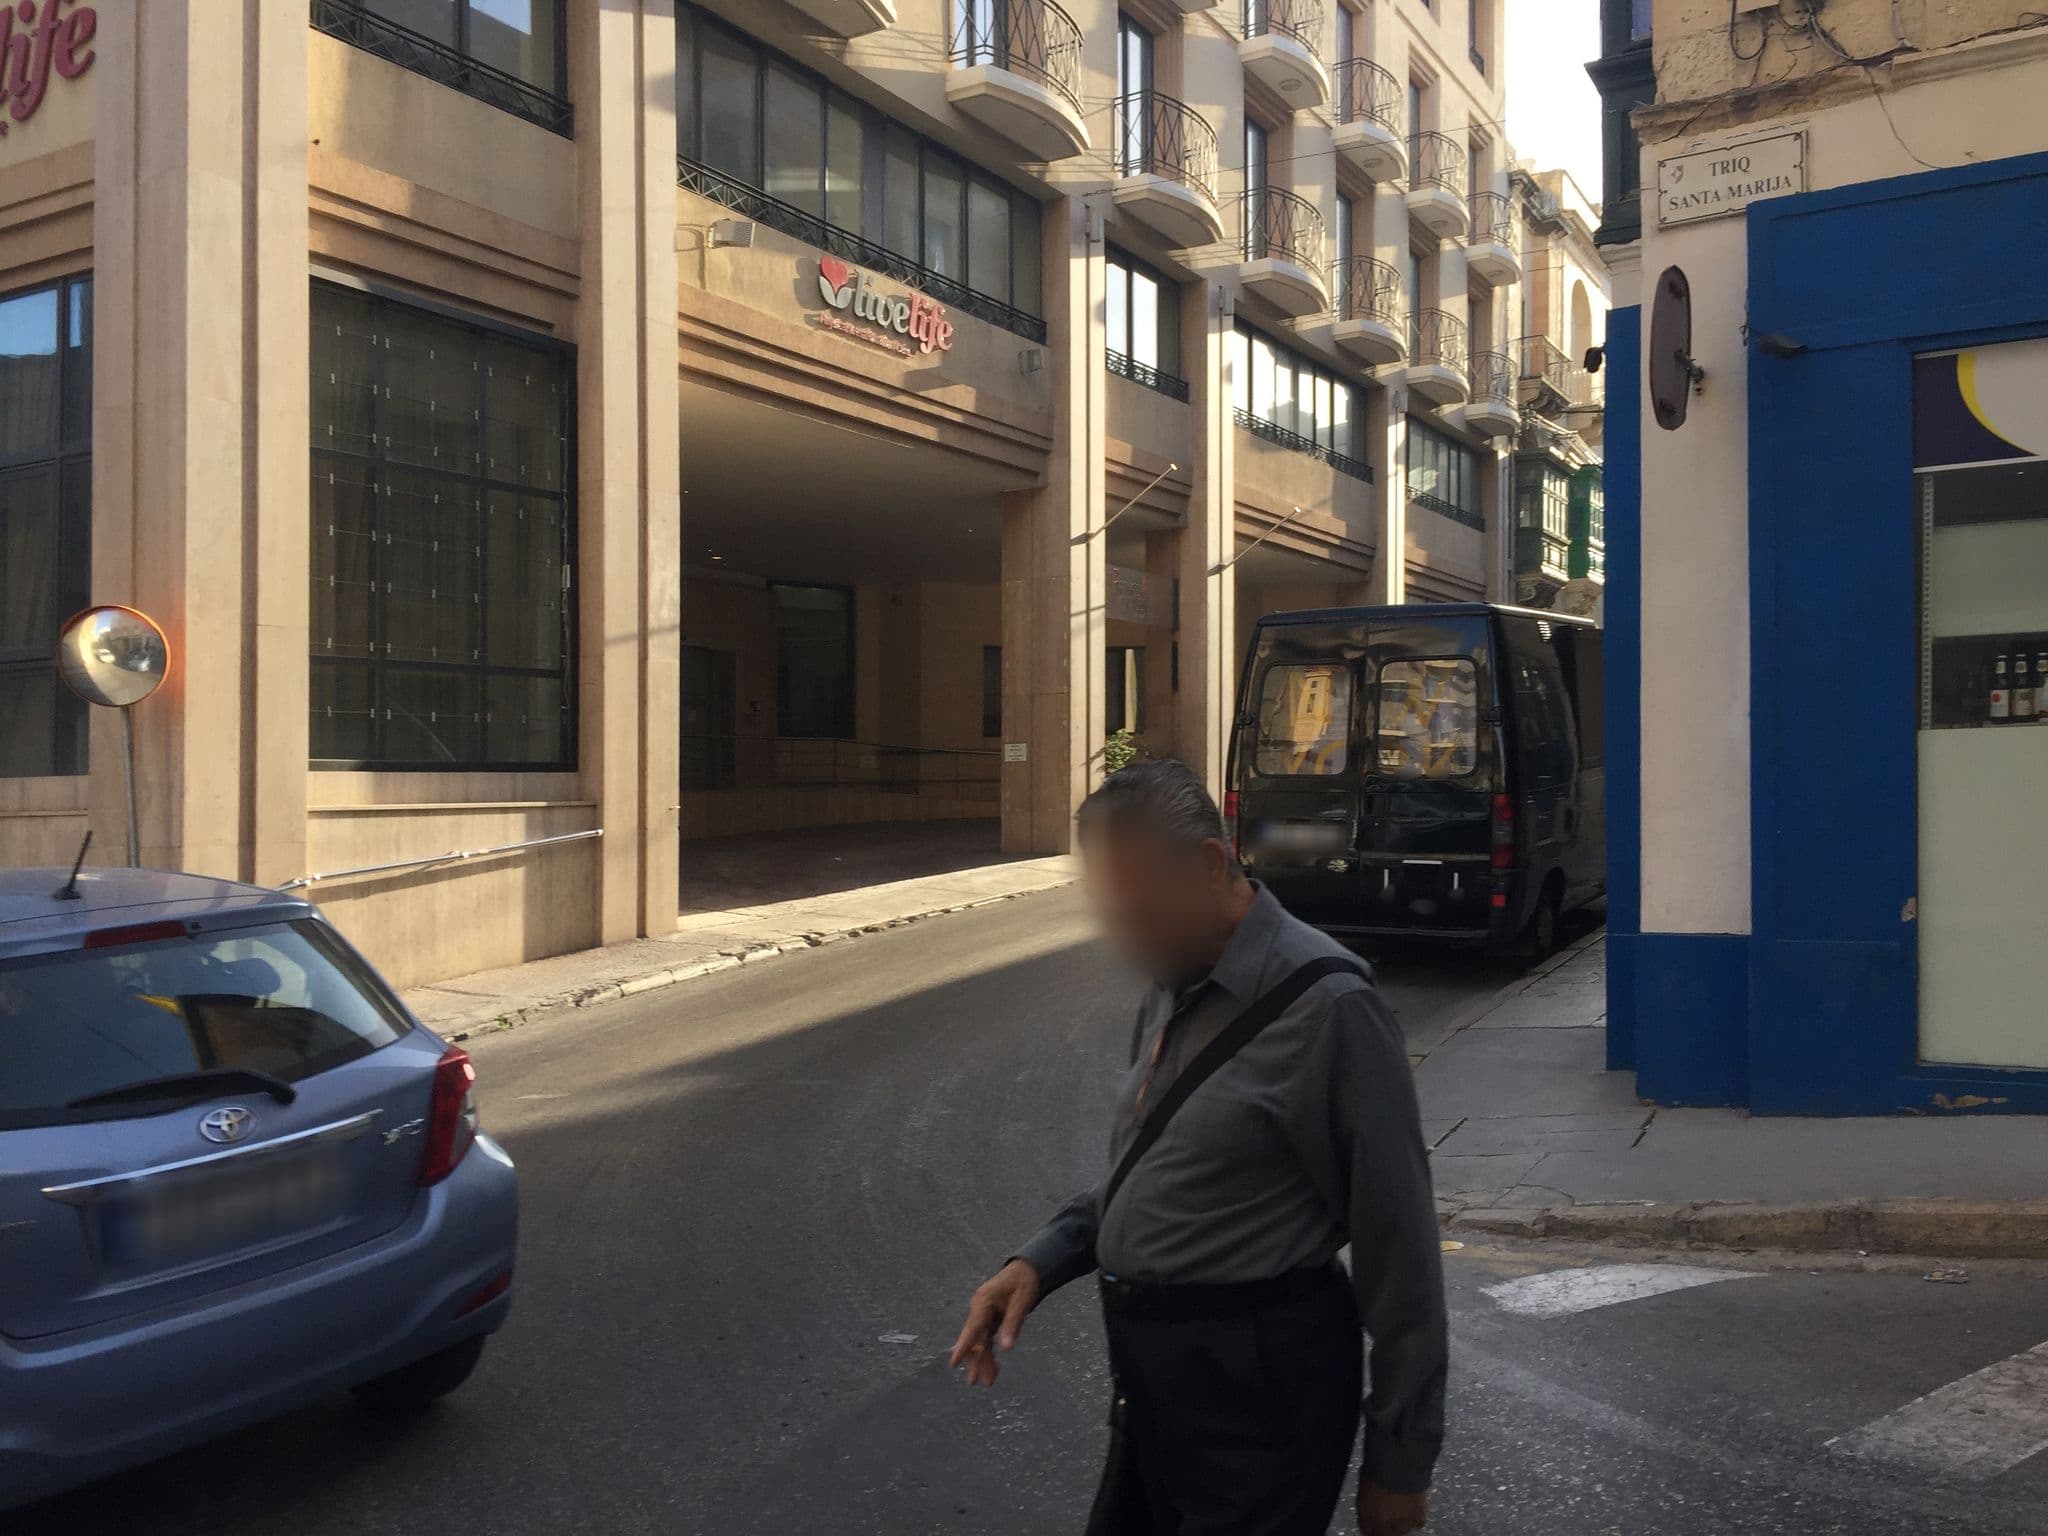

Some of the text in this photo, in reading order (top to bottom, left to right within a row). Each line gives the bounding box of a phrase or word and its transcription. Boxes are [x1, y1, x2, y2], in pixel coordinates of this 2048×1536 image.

[1708, 156, 1751, 177] TRIQ
[1669, 176, 1792, 211] SANTA MARIJA
